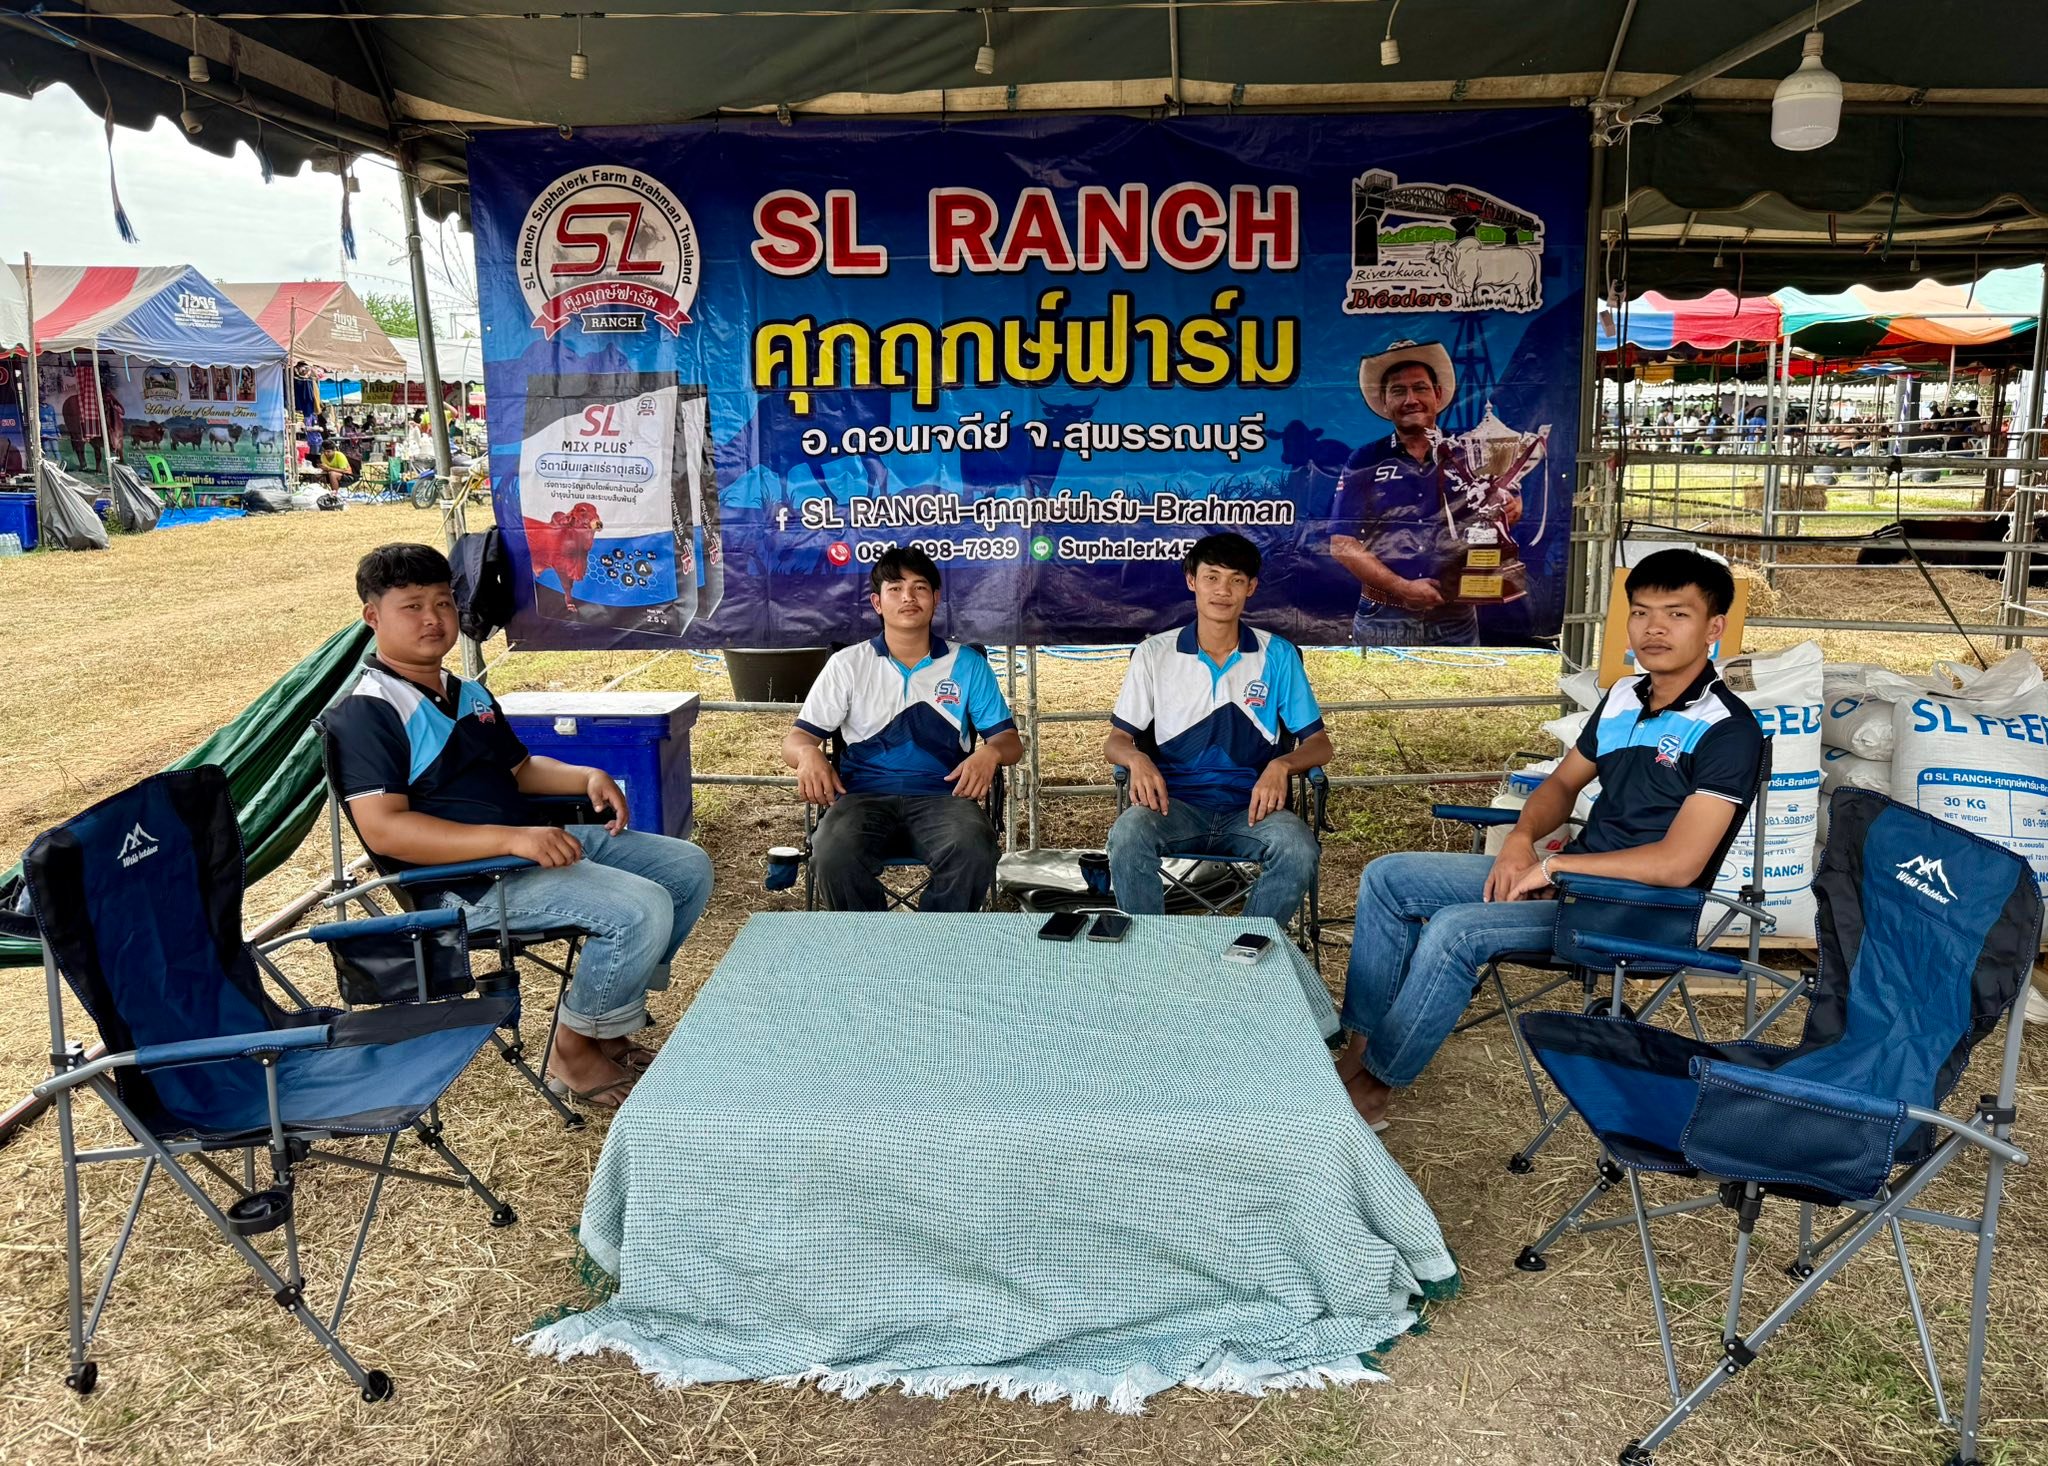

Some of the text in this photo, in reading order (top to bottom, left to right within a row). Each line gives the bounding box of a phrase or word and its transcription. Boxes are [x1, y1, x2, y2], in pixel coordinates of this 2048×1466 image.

[520, 169, 693, 290] SL Ranch Suphalerk Farm Brahman Thailand
[550, 202, 664, 277] SL
[750, 181, 1299, 276] SL RANCH
[1346, 288, 1453, 310] Breeders
[591, 317, 637, 328] RANCH
[755, 288, 1295, 415] ศุภฤกษ์ฟาร์ม
[579, 403, 621, 437] SL
[561, 440, 588, 452] MIX
[801, 410, 1266, 461] อ.ดอนเจดีย์ จ.สุพรรณบุรี
[1374, 465, 1403, 482] SL
[801, 496, 844, 530] SL
[638, 563, 648, 573] A
[1751, 704, 1824, 735] EED
[1912, 698, 2048, 745] SL FEE
[1935, 773, 1950, 782] SL
[1943, 796, 1987, 810] 30 KG
[1944, 812, 1988, 824] NET WEIGHT
[1764, 863, 1804, 878] RANCH
